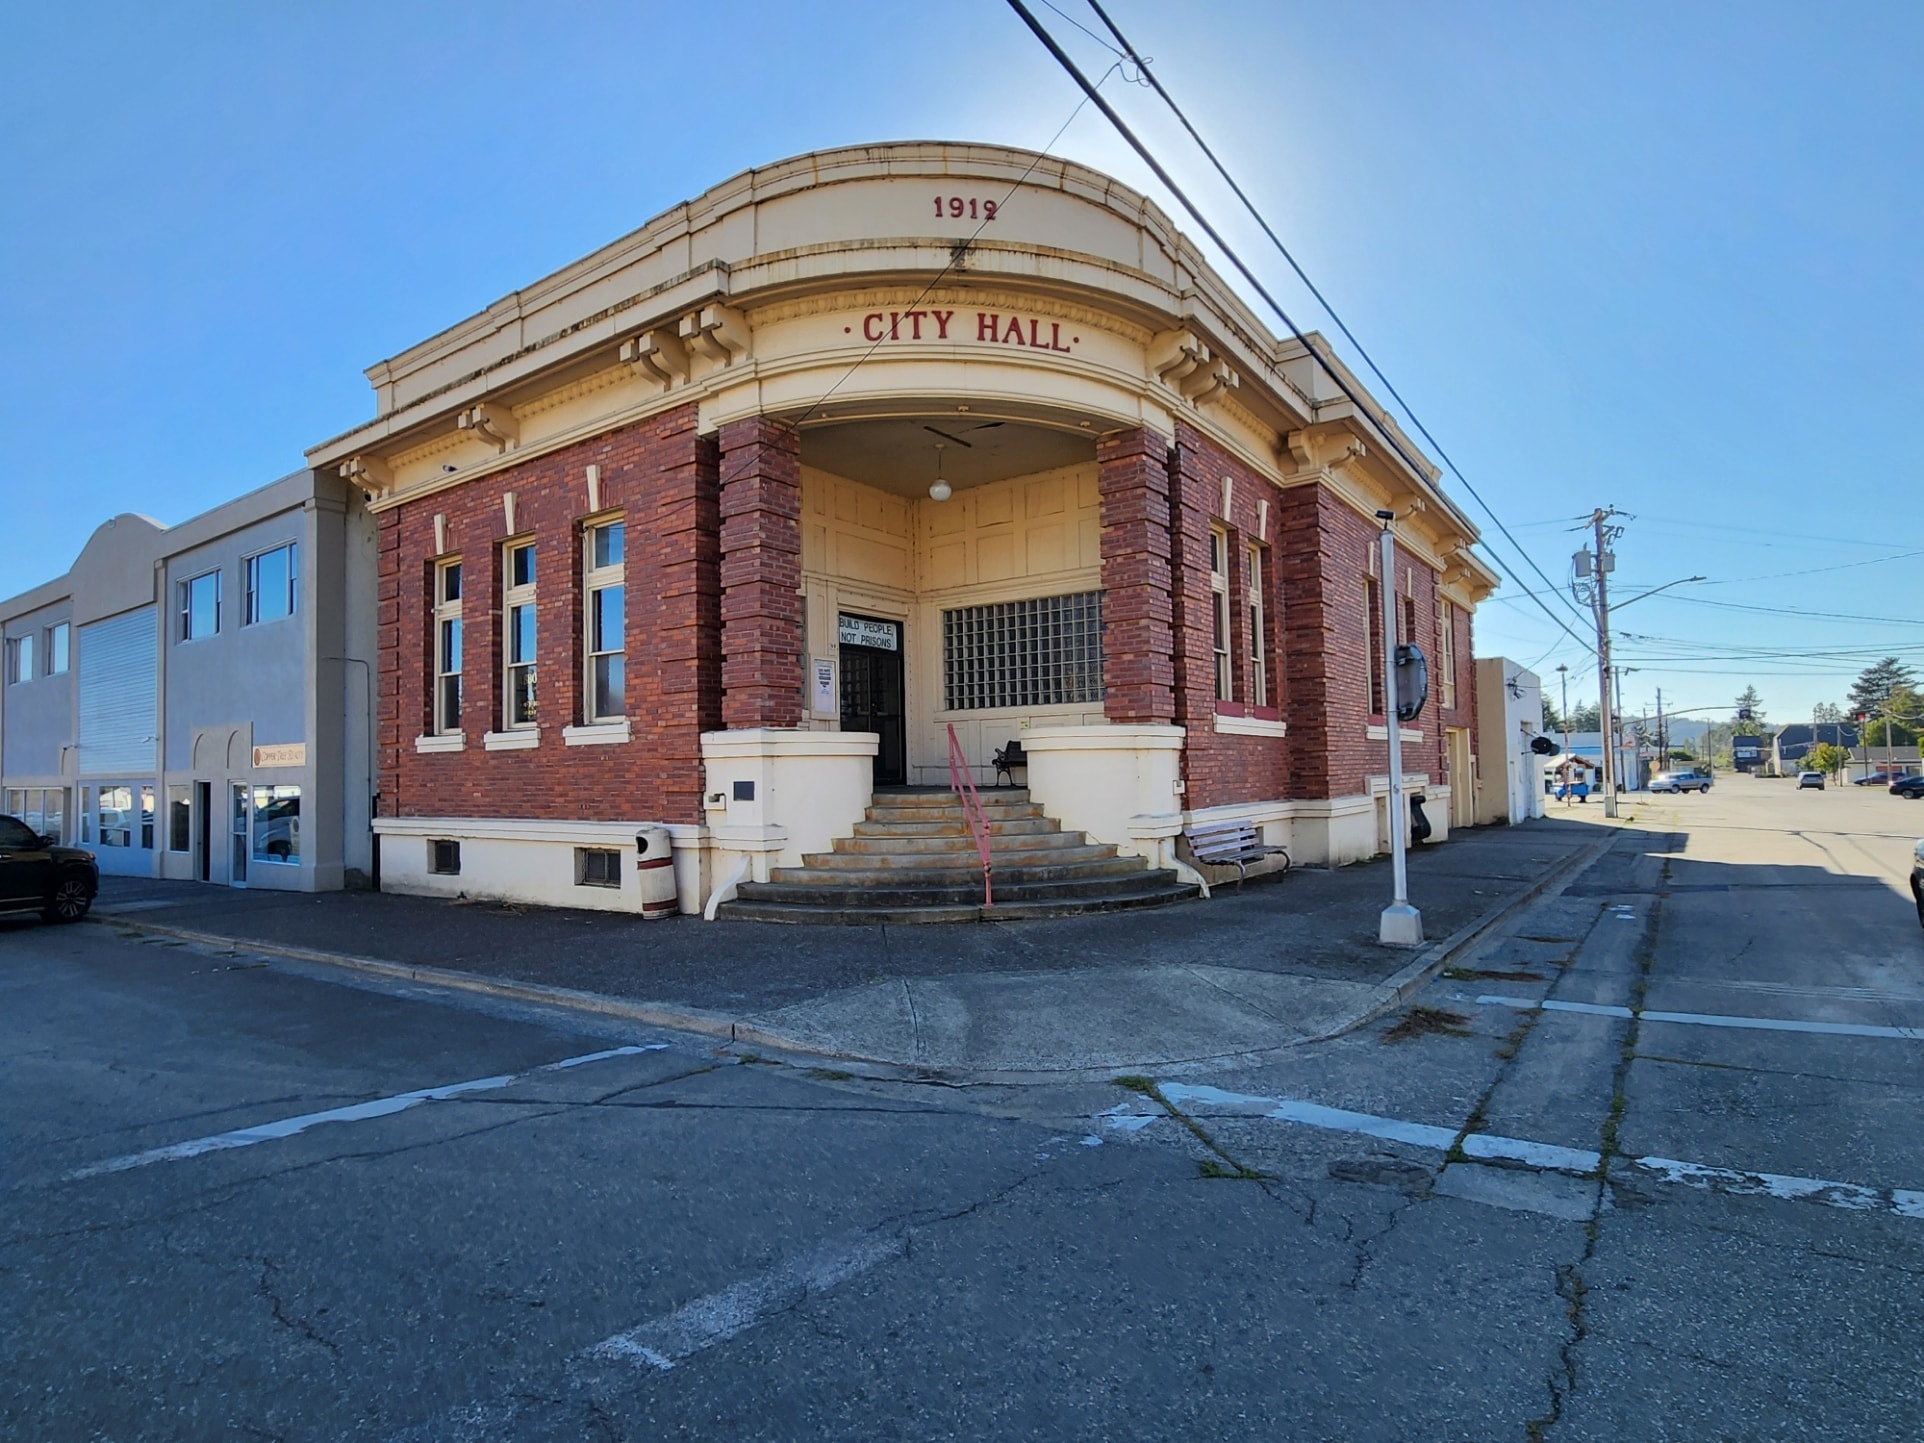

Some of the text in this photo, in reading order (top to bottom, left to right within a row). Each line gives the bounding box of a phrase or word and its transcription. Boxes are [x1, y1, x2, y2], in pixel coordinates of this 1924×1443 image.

[934, 196, 997, 220] 1912
[863, 310, 1070, 352] CITY HALL
[840, 617, 859, 630] BUILD
[841, 632, 891, 649] NOT PRISONS
